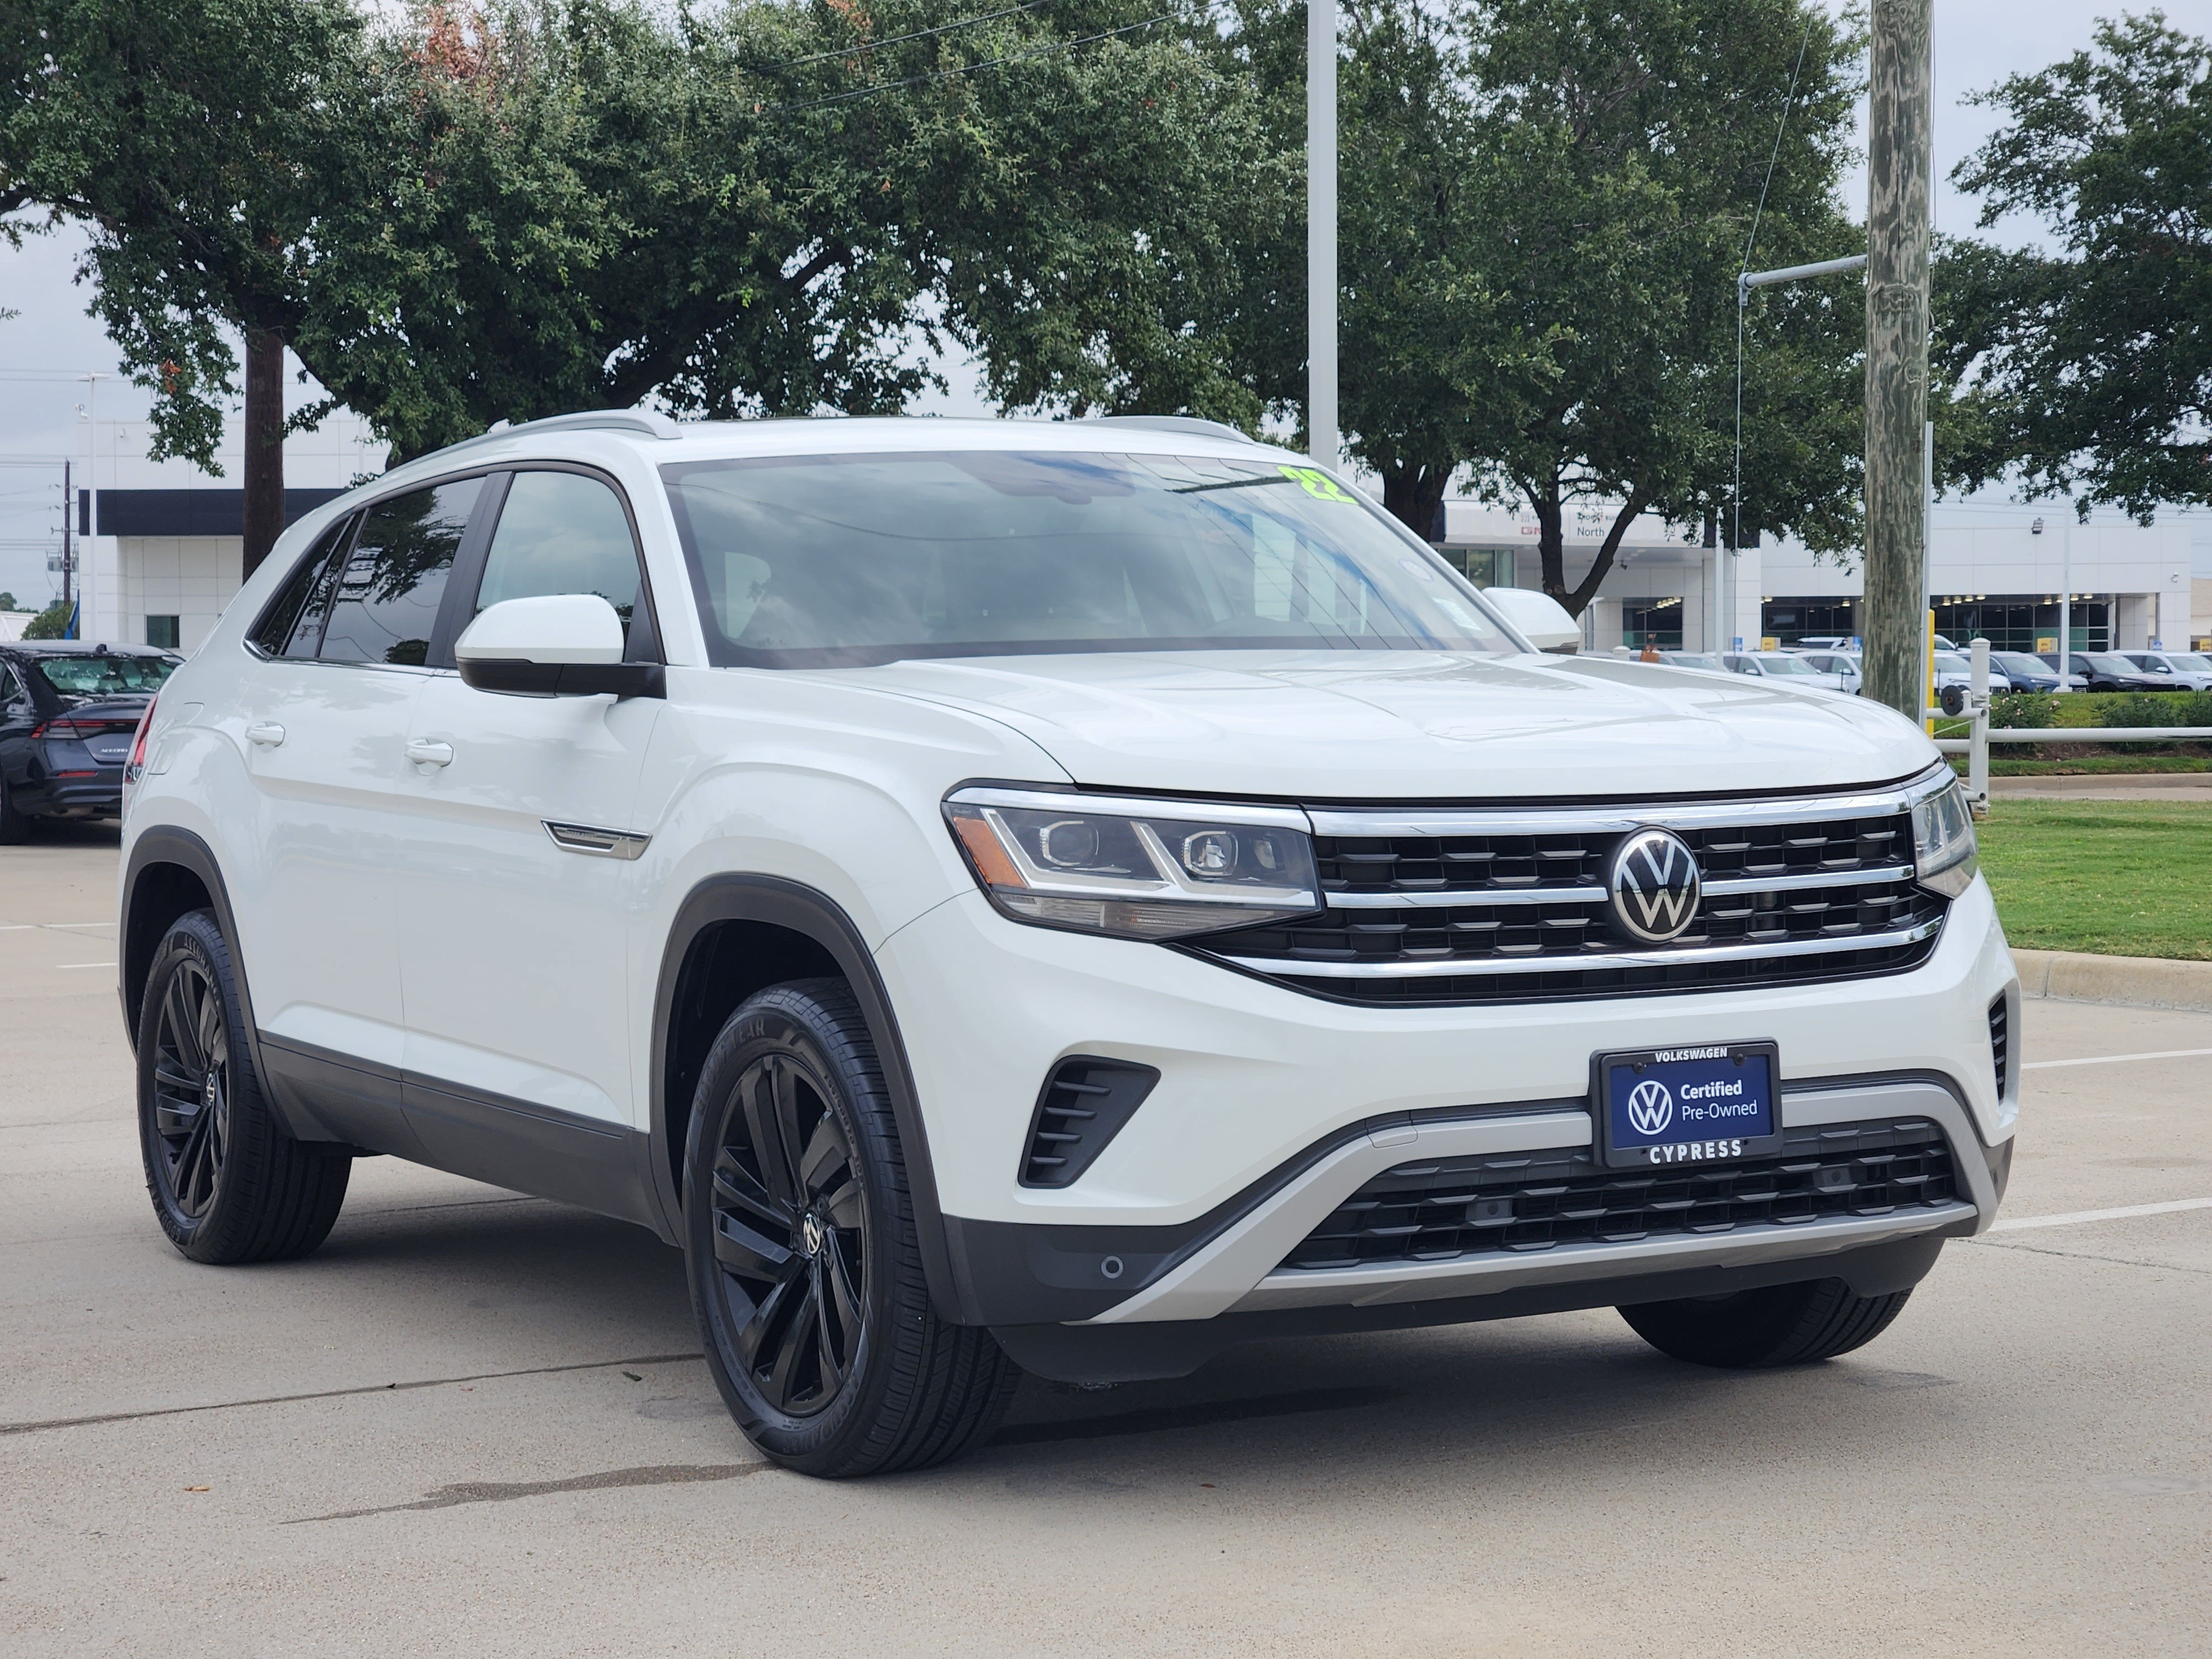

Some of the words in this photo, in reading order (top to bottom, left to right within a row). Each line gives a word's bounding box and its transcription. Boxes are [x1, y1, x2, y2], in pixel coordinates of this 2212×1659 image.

[1277, 466, 1359, 504] 22
[1577, 526, 1605, 536] North
[1655, 1047, 1728, 1063] VOLKSWAGEN
[1680, 1079, 1743, 1100] Certified
[1682, 1099, 1757, 1121] Pre-Owned
[1650, 1139, 1742, 1165] CYPRESS
